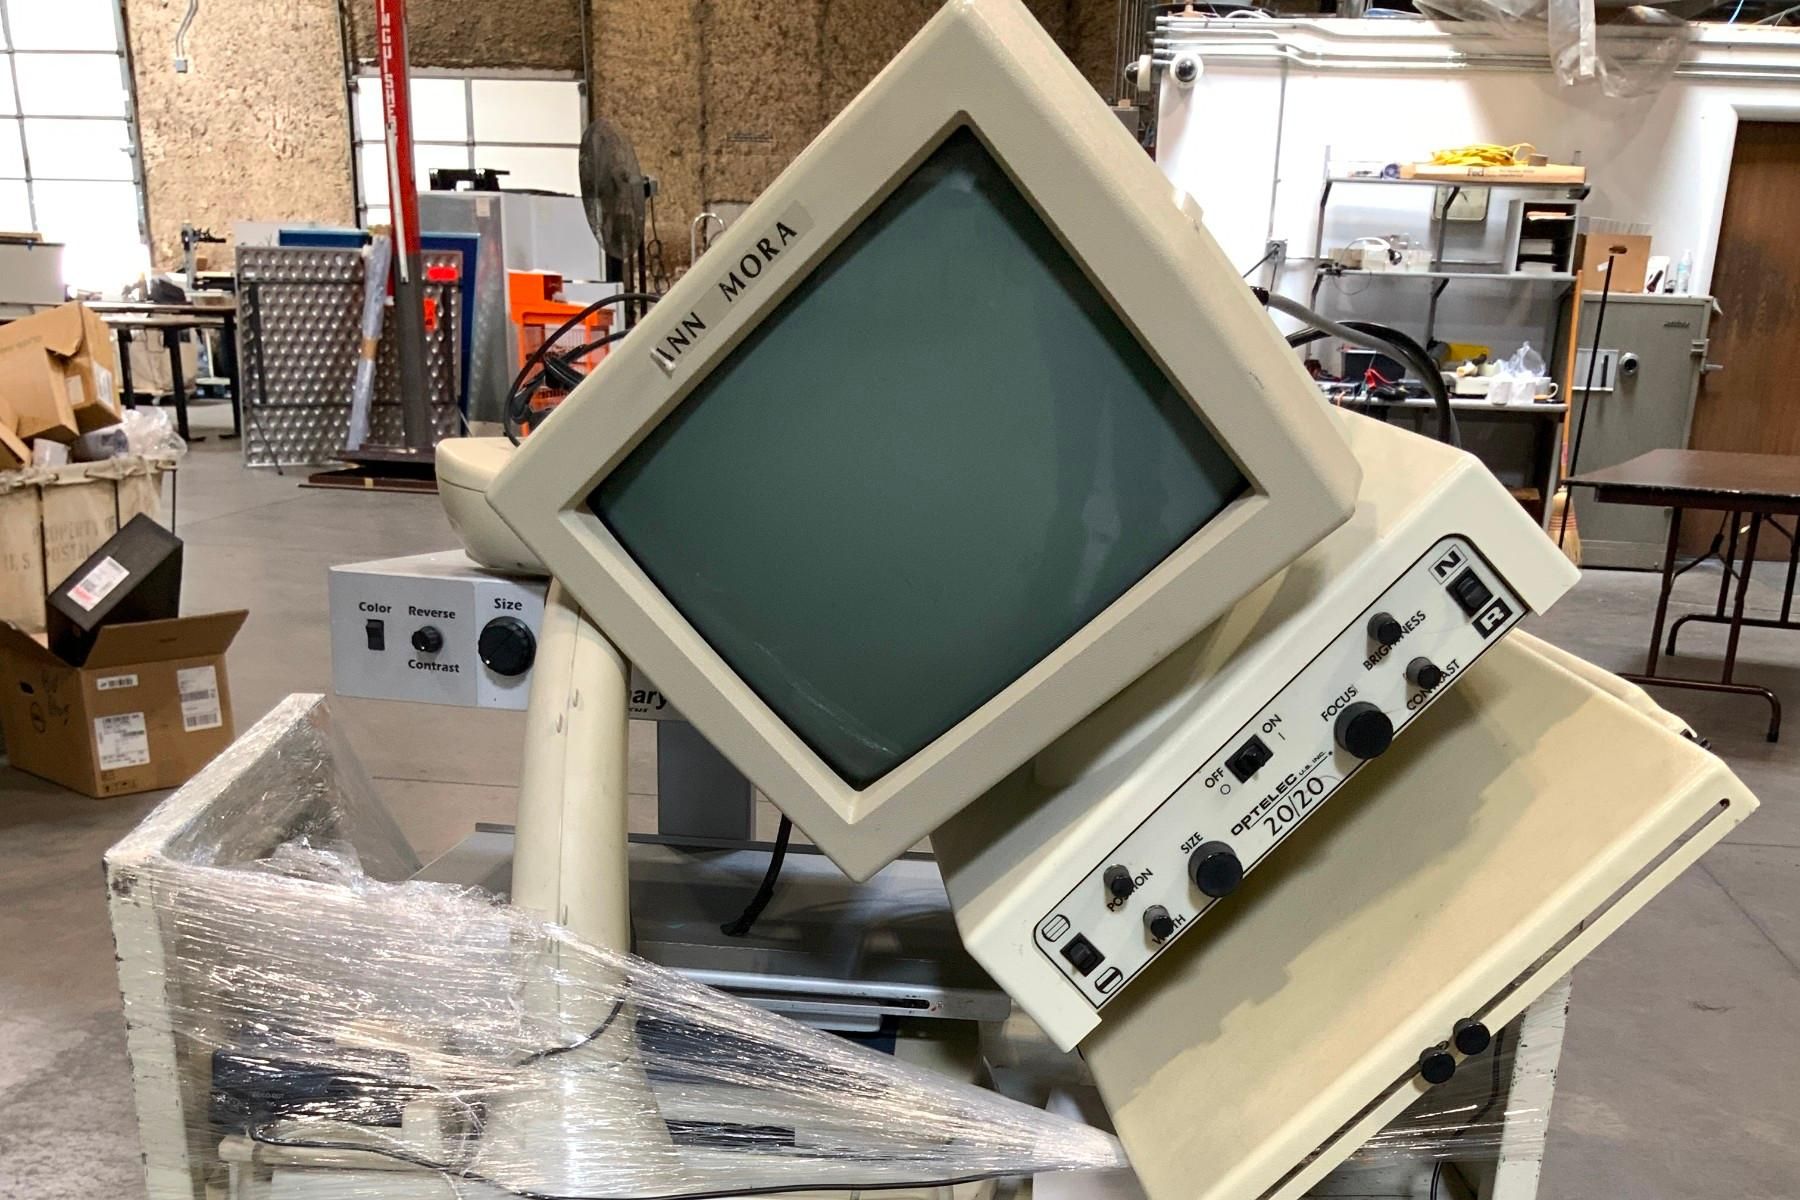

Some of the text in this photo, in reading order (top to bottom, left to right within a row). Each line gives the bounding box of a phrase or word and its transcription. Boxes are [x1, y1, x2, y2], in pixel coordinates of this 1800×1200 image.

[718, 222, 797, 302] MORA
[1434, 550, 1461, 578] N
[359, 601, 392, 614] Color
[408, 605, 456, 619] Reverse
[494, 598, 523, 611] Size
[1479, 605, 1505, 631] R
[1362, 610, 1427, 671] BRIGNESS
[408, 659, 460, 673] Contrast
[1406, 658, 1460, 711] CONAST
[1320, 685, 1358, 722] FOCUS
[1262, 714, 1282, 734] ON
[1204, 767, 1225, 789] OFF
[1230, 773, 1297, 836] OPTELEC
[1263, 776, 1324, 837] 20/20
[1180, 832, 1204, 854] SIZE
[1106, 868, 1154, 912] POION
[1151, 914, 1186, 945] WTH
